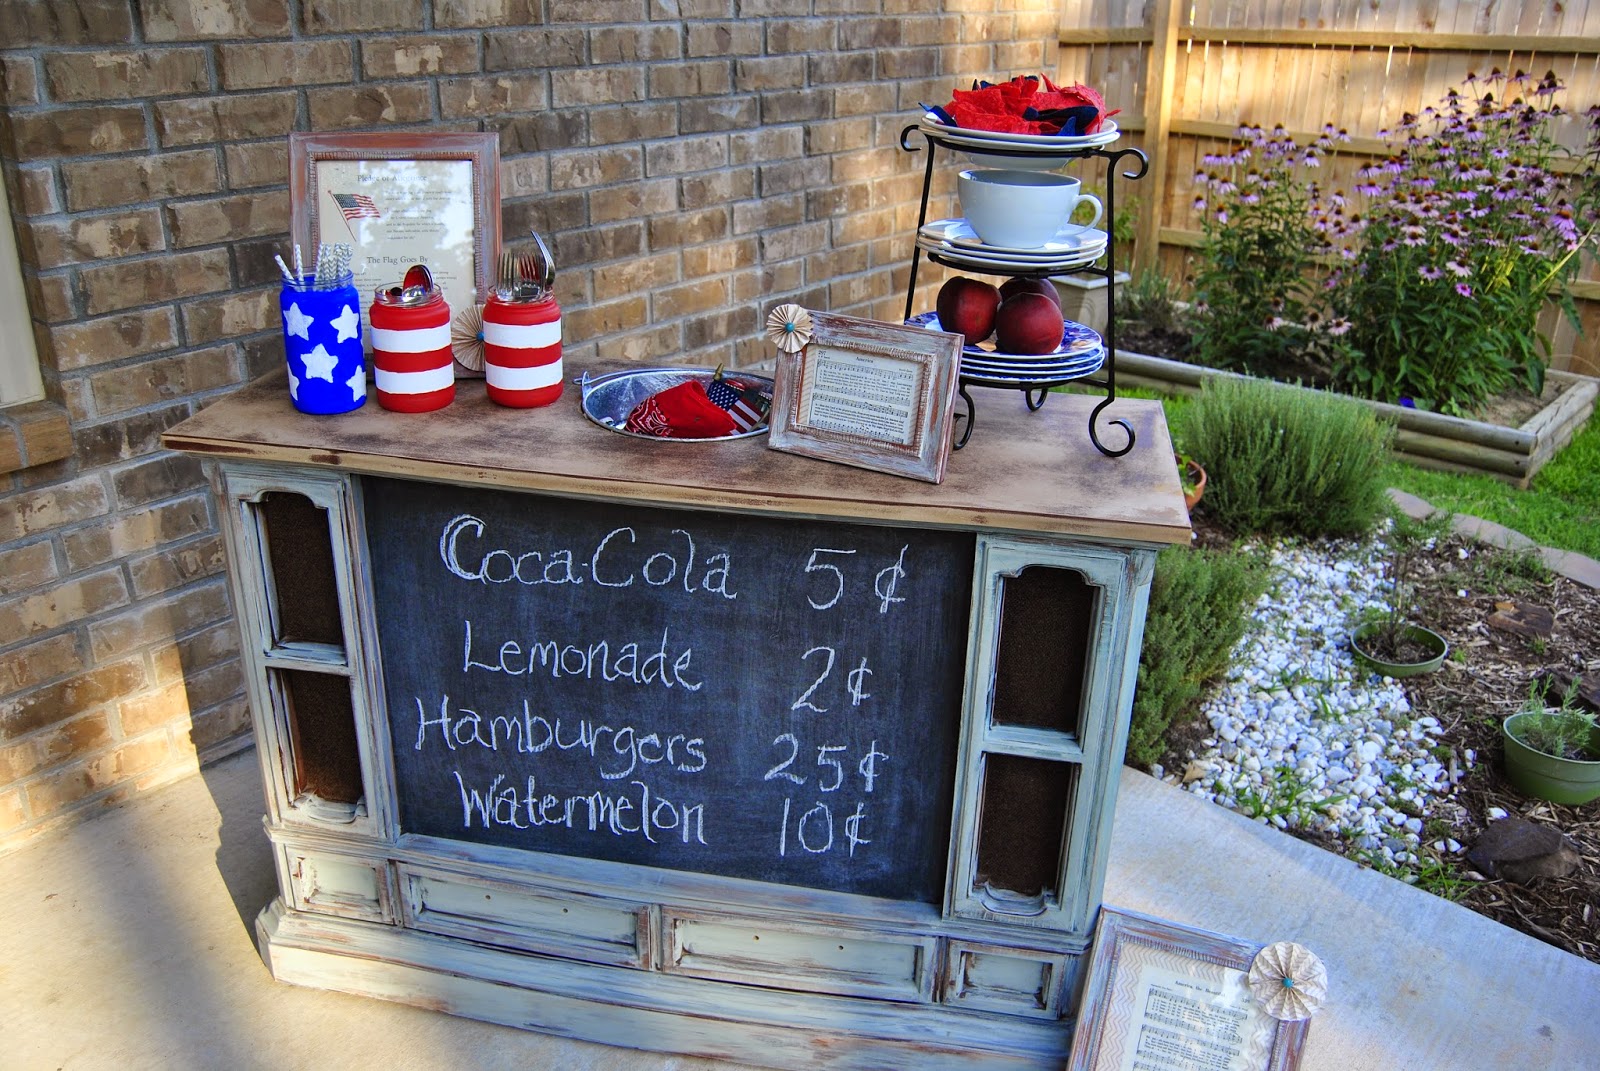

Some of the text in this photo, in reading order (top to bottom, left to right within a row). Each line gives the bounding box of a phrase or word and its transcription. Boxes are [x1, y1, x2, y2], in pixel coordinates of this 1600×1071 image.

[366, 255, 429, 266] The Flag Goes By
[439, 513, 739, 600] Coca-Cola
[463, 619, 704, 692] Lemonade
[414, 694, 708, 781] Hamburgers
[453, 770, 708, 846] Watermelon
